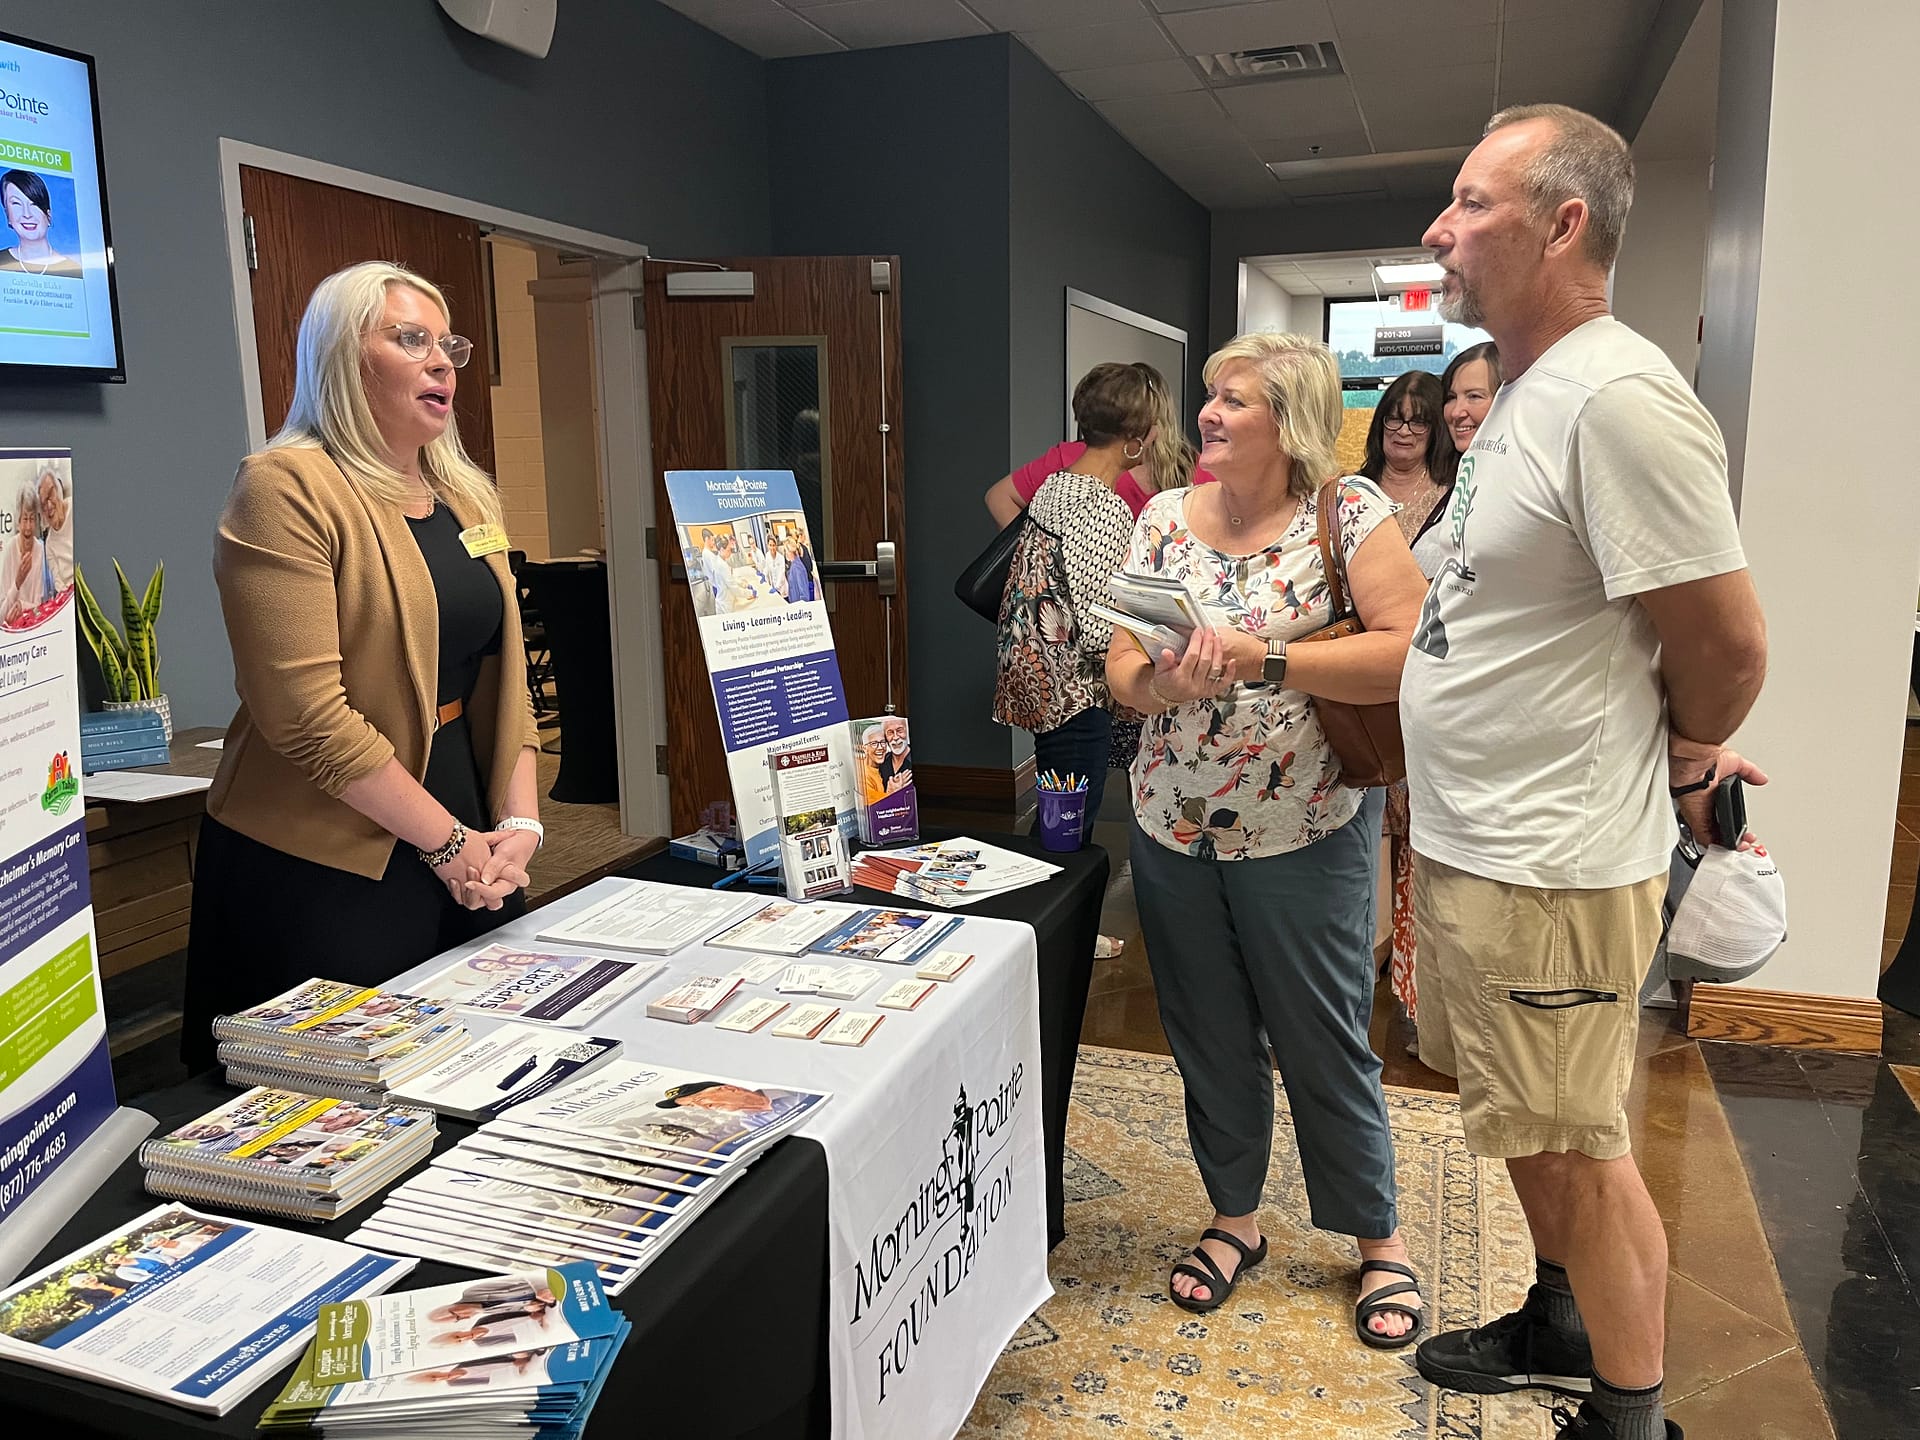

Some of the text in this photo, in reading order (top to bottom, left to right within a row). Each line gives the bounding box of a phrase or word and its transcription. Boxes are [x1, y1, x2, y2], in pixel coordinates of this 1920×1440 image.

[15, 111, 38, 124] Living
[1405, 290, 1429, 310] EXIT
[1384, 330, 1411, 338] 201-203
[1380, 343, 1434, 353] KIDS/STUDENTS
[705, 480, 768, 493] Morning Pointe
[717, 496, 766, 509] FOUNDATION
[722, 609, 813, 632] Living Learning Leading
[0, 645, 48, 669] Memory Care
[7, 669, 27, 688] Living
[782, 739, 803, 750] Regional
[0, 832, 81, 888] zheimer's Memory Care
[286, 983, 327, 1005] SENIOR
[480, 967, 552, 1010] SUPPORT
[524, 972, 567, 996] Group
[226, 1092, 275, 1119] SENIOR
[537, 1069, 659, 1120] Milestones
[232, 1094, 290, 1125] SERVICE
[0, 1131, 67, 1212] (877) 776-4683
[850, 1060, 1024, 1325] Morning Pointe
[181, 1256, 195, 1265] You
[877, 1154, 1016, 1404] FOUNDATION
[406, 1334, 421, 1350] Aging
[197, 1349, 251, 1387] Morning
[249, 1322, 290, 1352] Pointe
[390, 1347, 404, 1366] Tough
